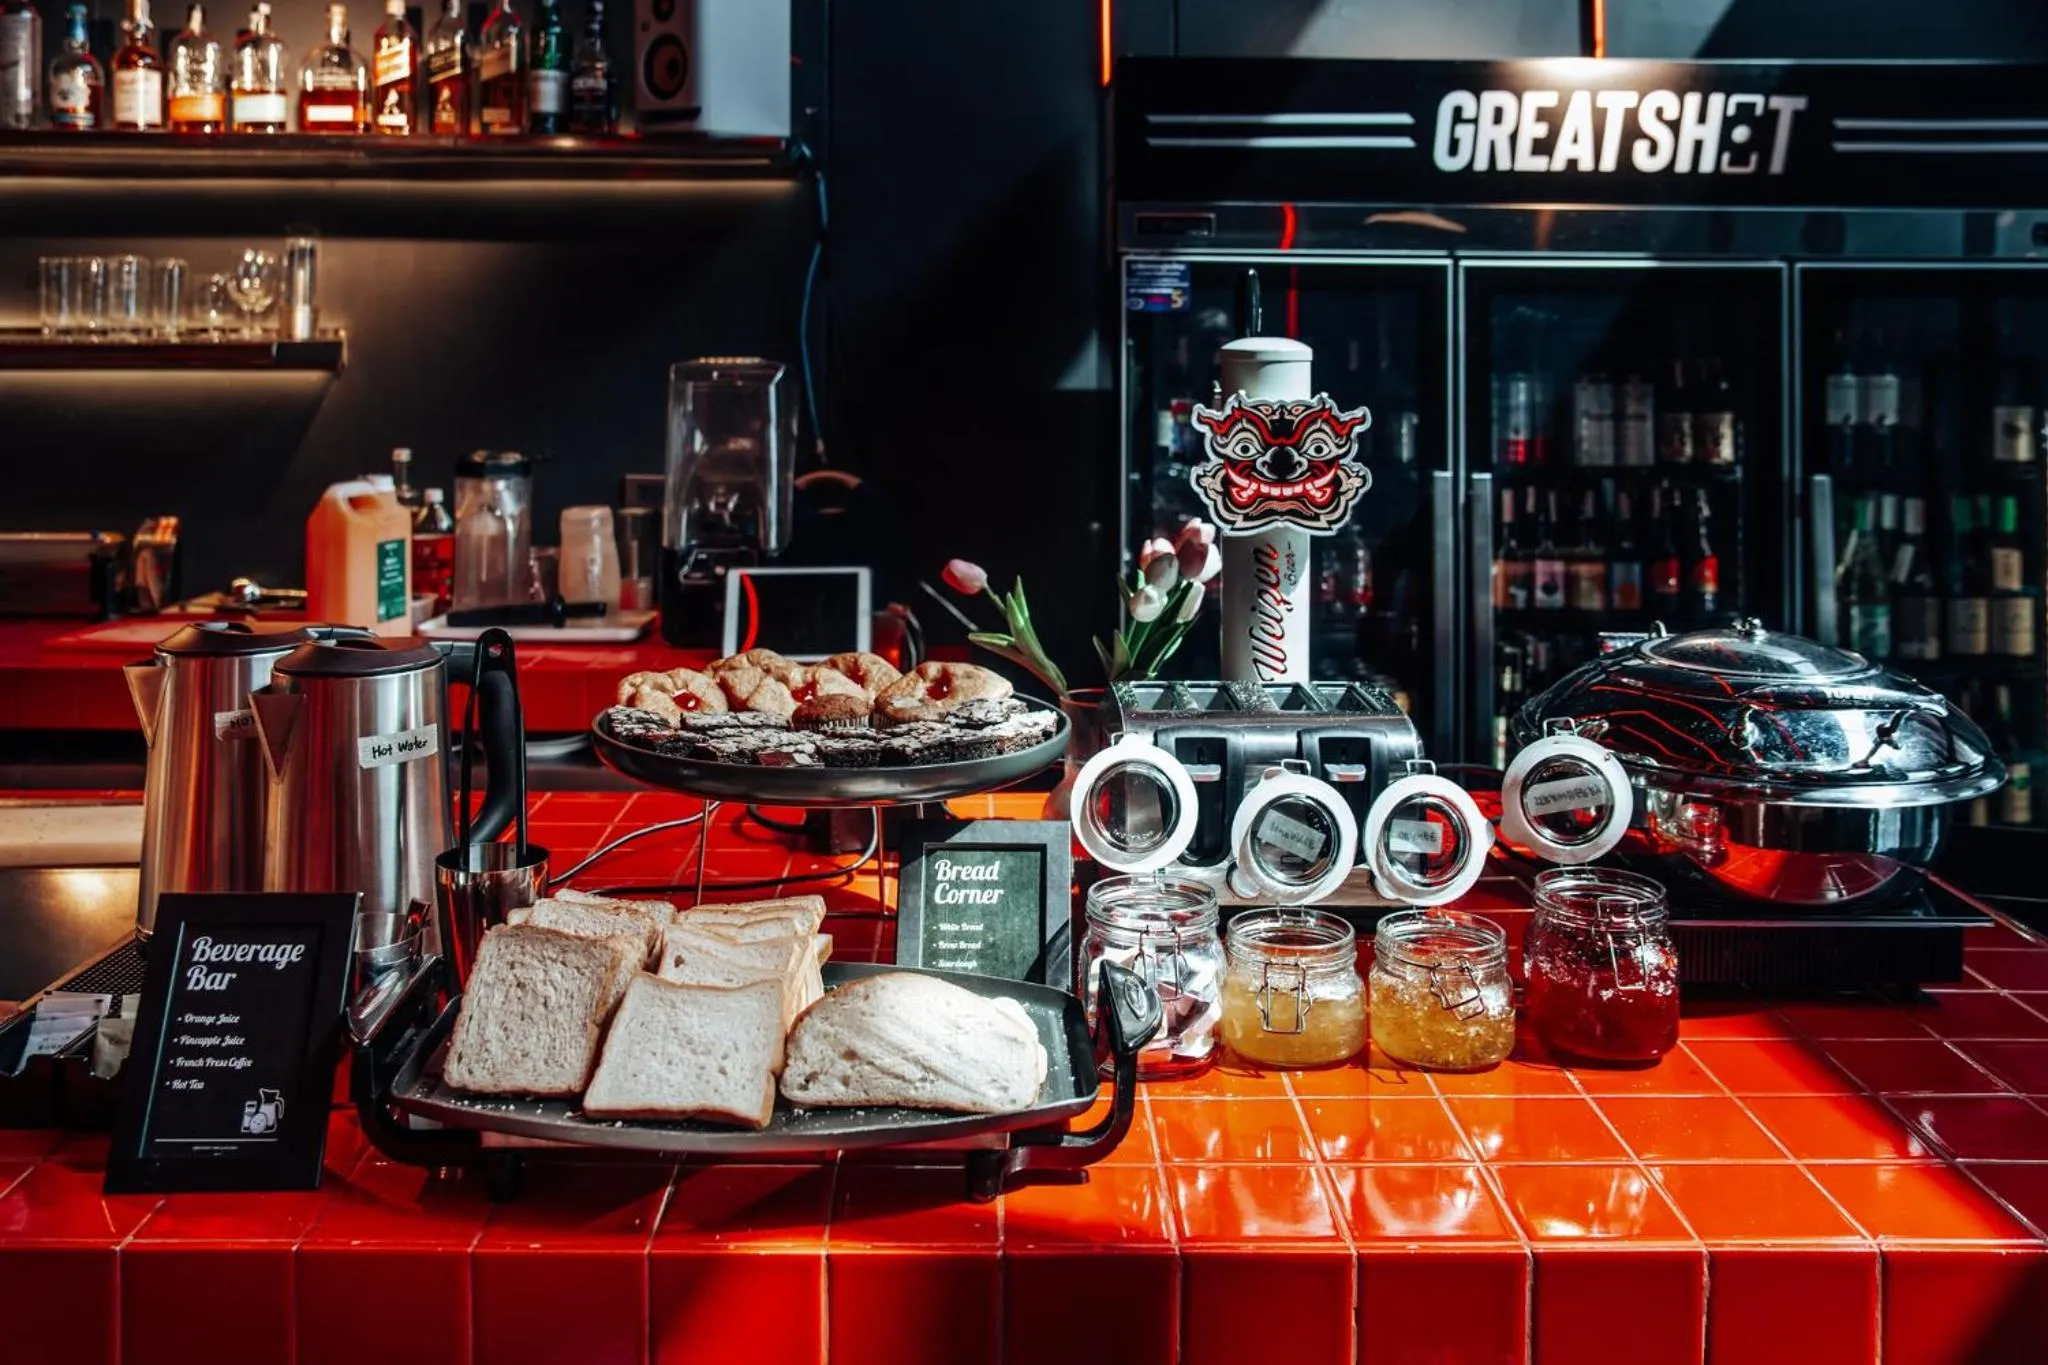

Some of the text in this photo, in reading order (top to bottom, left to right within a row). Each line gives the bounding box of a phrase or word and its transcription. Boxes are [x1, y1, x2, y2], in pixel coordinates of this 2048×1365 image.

[372, 735, 429, 760] Hot Water
[934, 859, 1000, 881] Bread
[934, 883, 1004, 905] Corner
[191, 936, 305, 970] Beverage
[186, 964, 237, 991] Bar
[184, 1013, 240, 1026] Orange Juice
[179, 1034, 245, 1048] Pineapple Juice
[175, 1056, 253, 1070] French Press Coffee
[171, 1079, 205, 1090] Hot Tea
